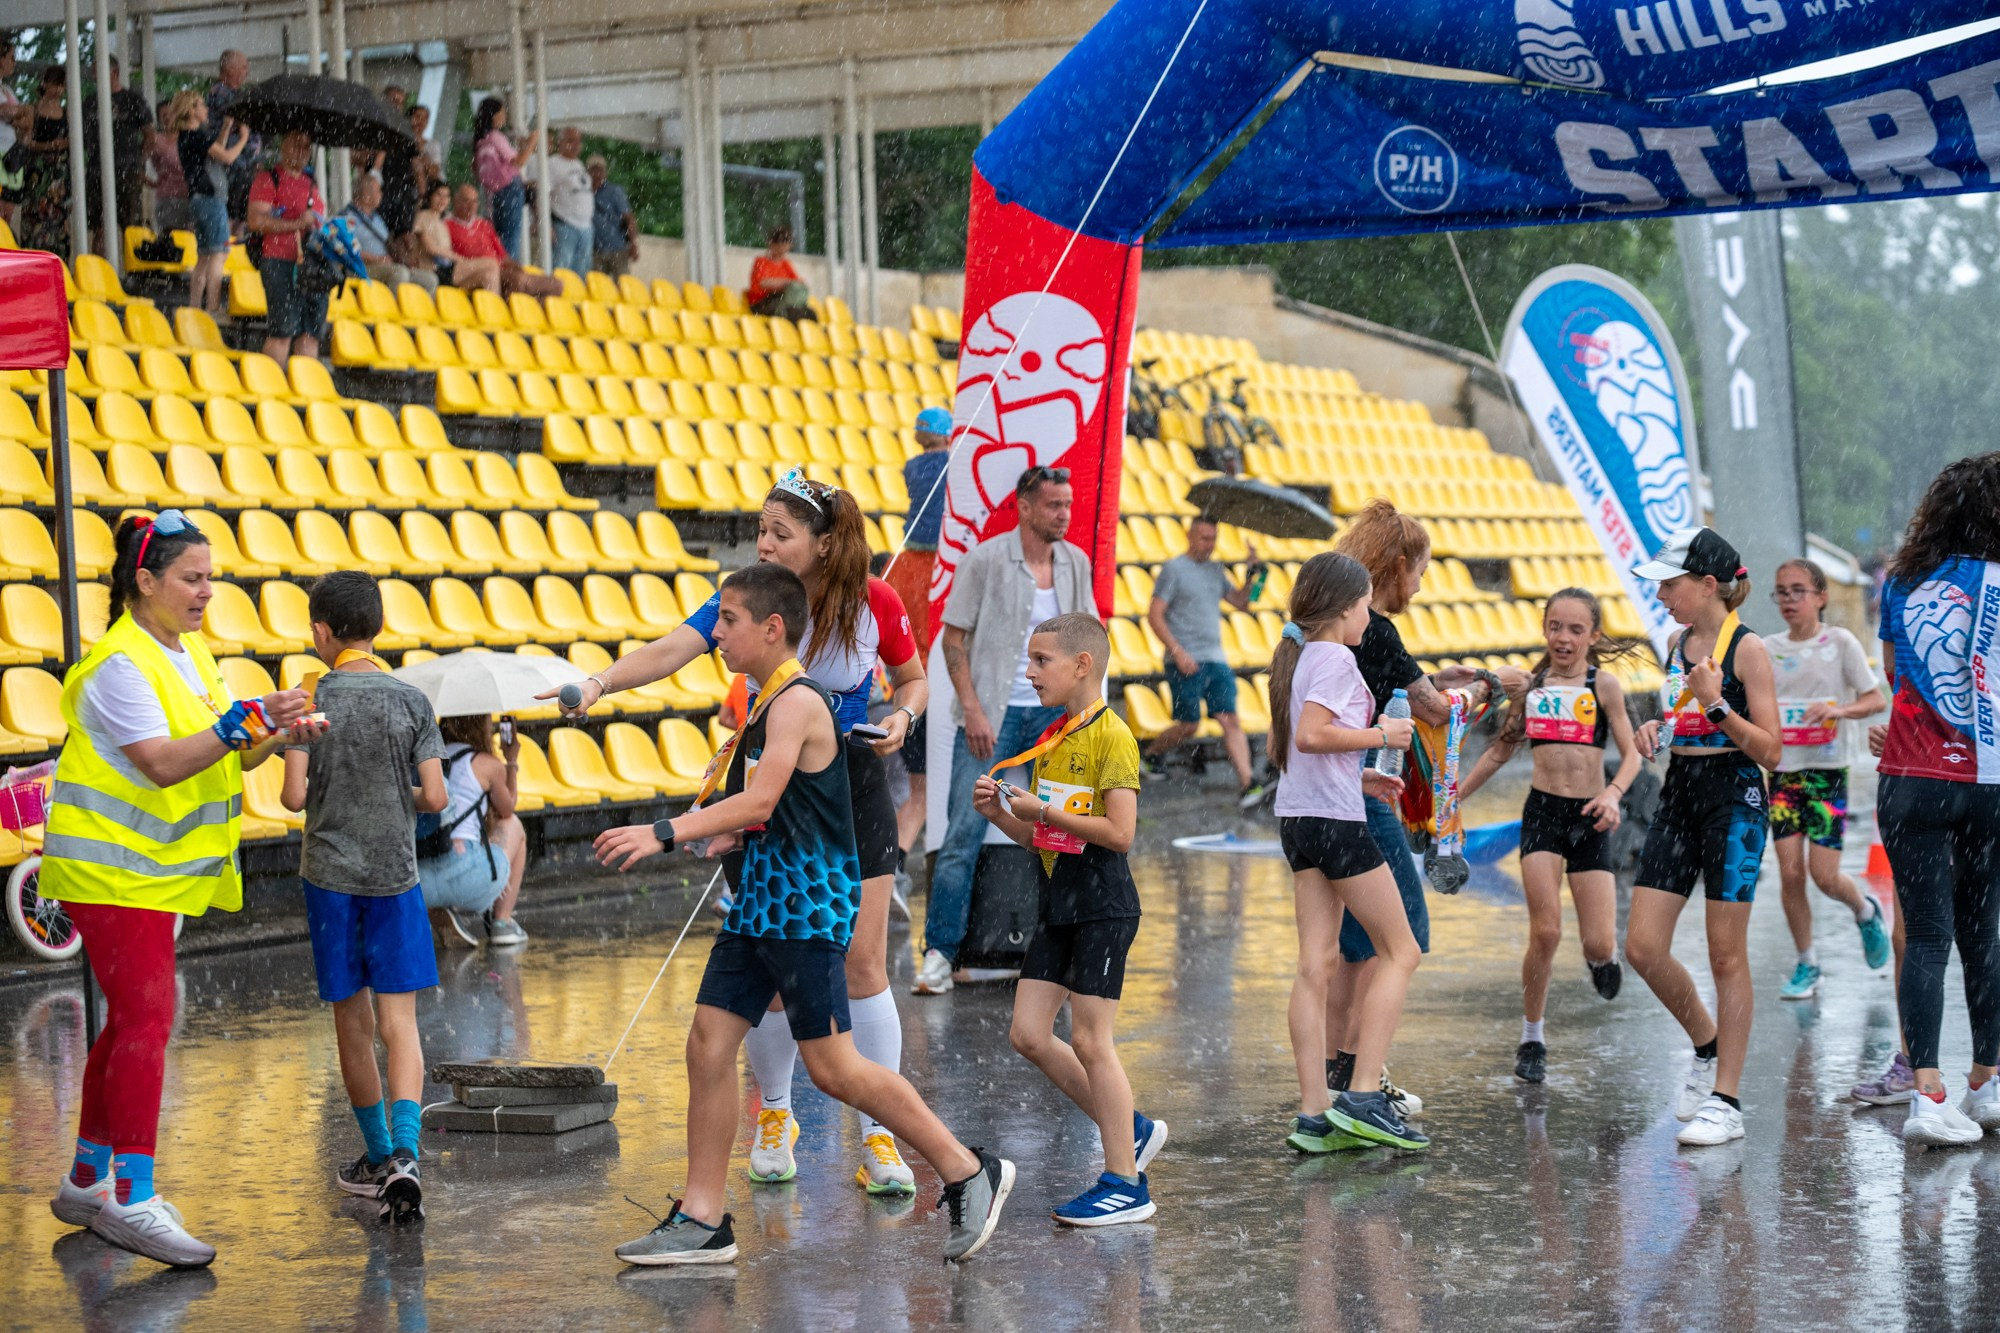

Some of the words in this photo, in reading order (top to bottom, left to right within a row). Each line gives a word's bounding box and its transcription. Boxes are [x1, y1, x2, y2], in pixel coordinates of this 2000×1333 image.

[1615, 0, 1787, 56] HILLS
[1555, 60, 2000, 213] START
[1389, 153, 1443, 183] P/H
[1975, 583, 2000, 657] MATTERS
[1537, 696, 1561, 715] 61
[1976, 693, 1994, 747] EVERY
